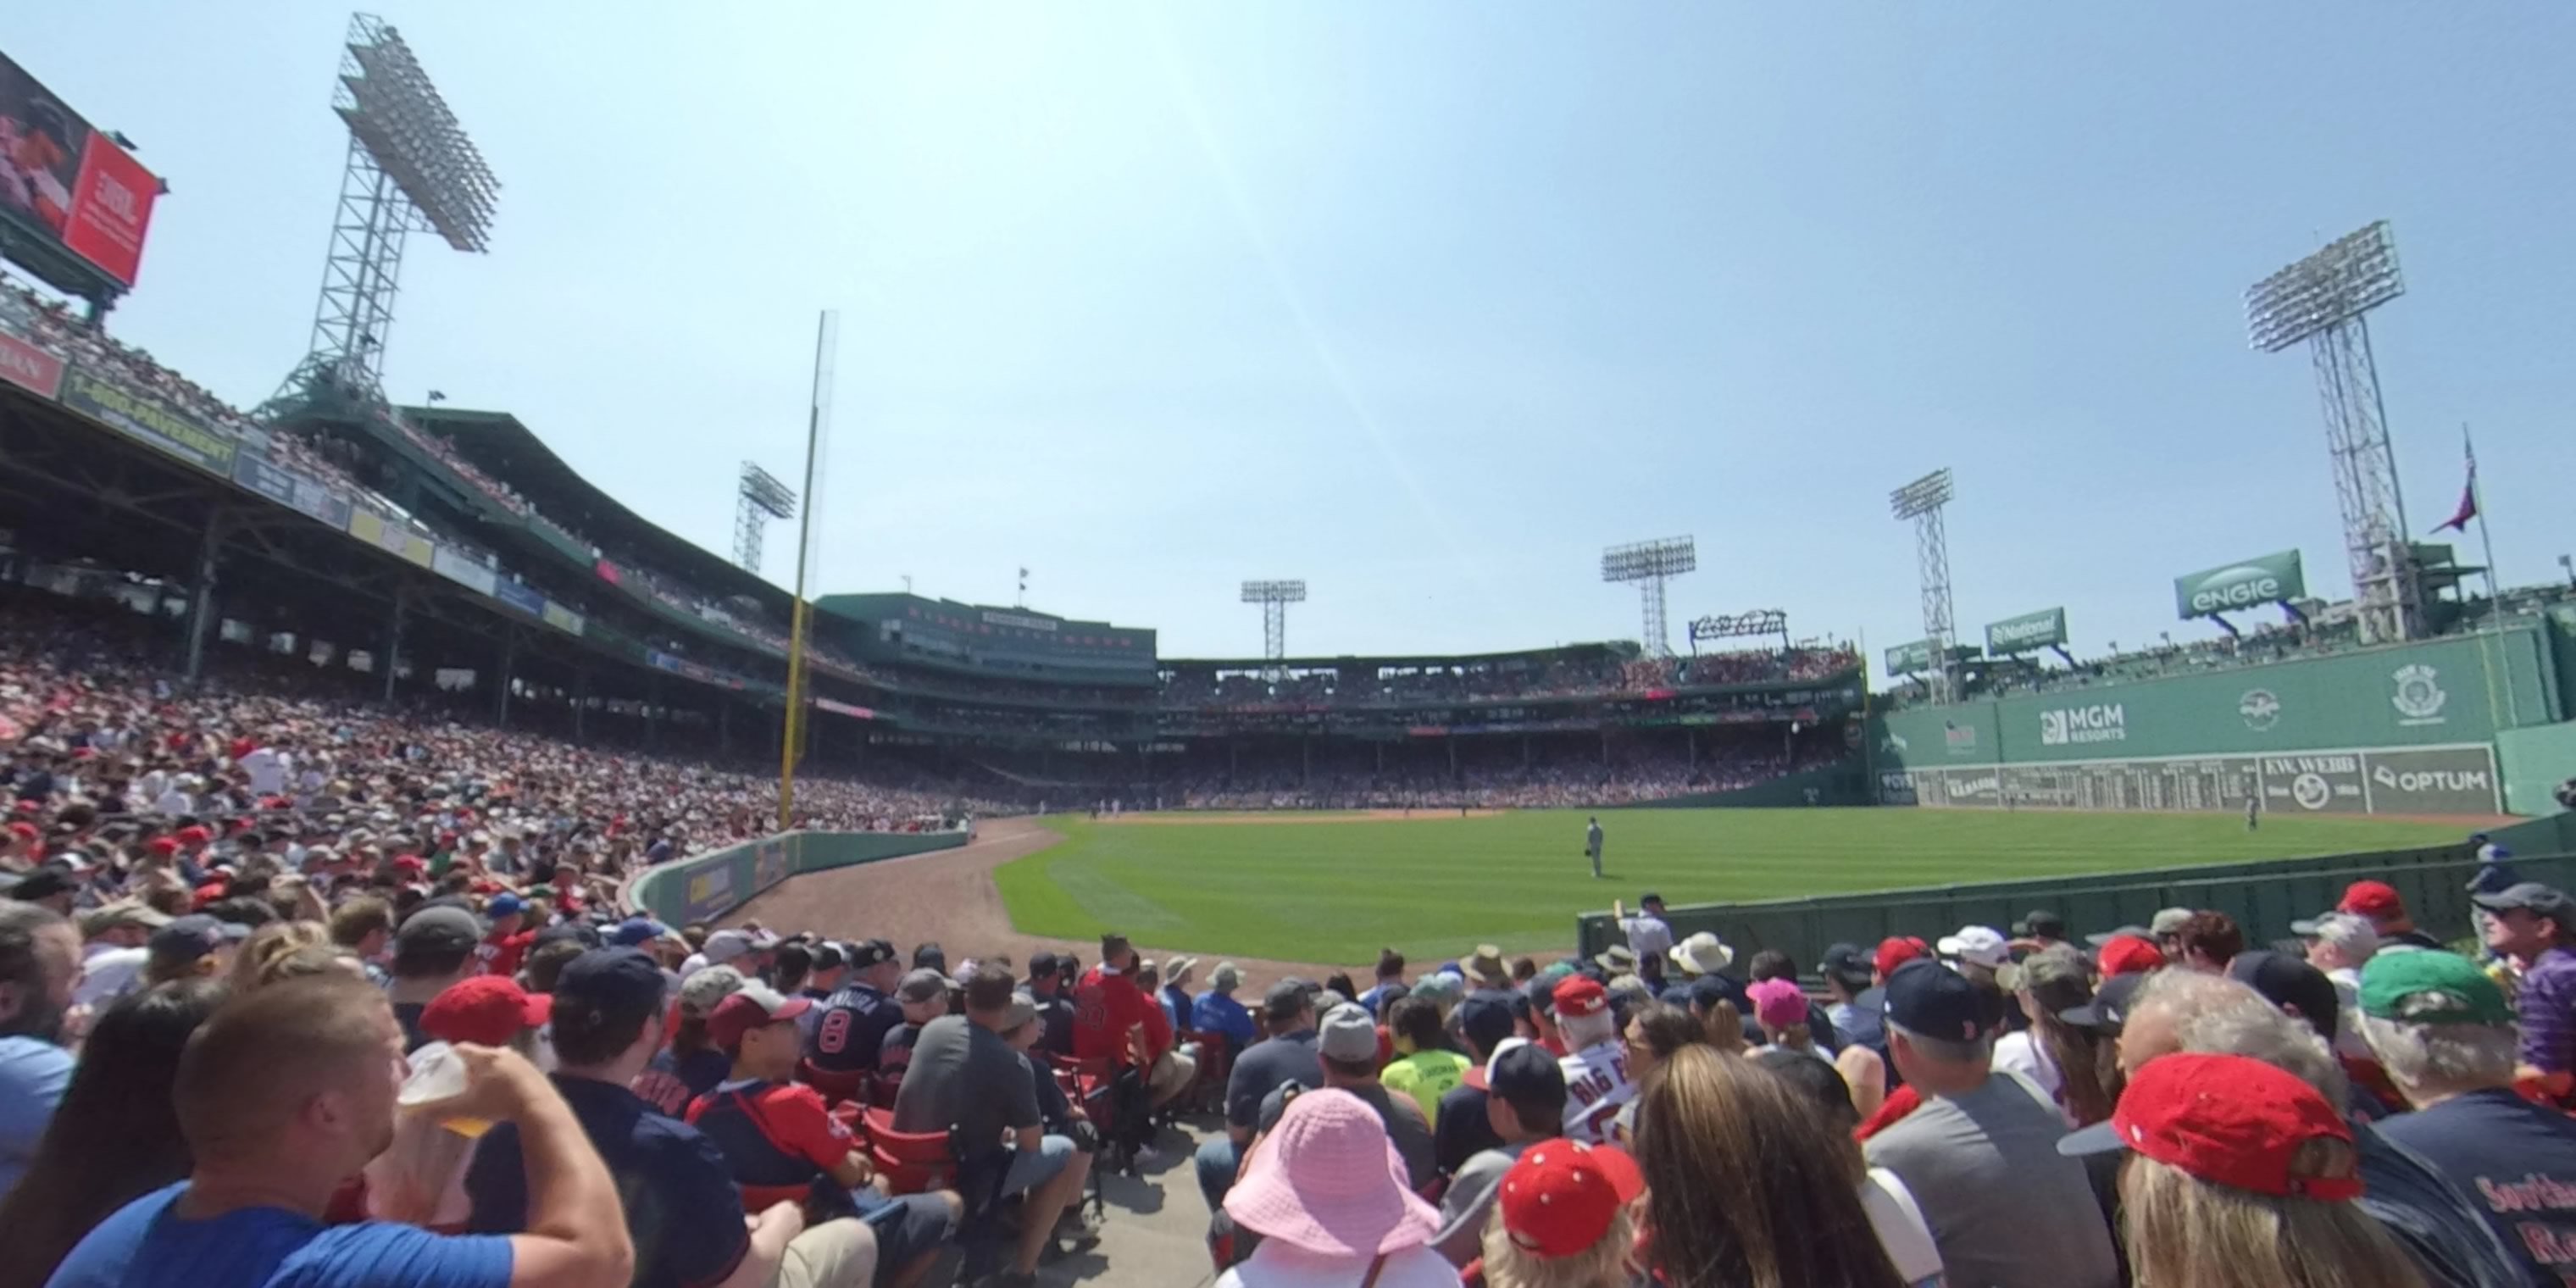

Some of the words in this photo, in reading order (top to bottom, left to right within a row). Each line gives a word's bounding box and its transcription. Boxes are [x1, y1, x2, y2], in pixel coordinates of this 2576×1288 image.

[2003, 615, 2056, 641] National
[2068, 703, 2124, 730] MGM
[2070, 728, 2125, 743] RESORTS
[2297, 756, 2356, 774] WEBB
[2399, 769, 2488, 792] OPTUM
[819, 1008, 852, 1054] 8
[1571, 1067, 1613, 1107] BIG
